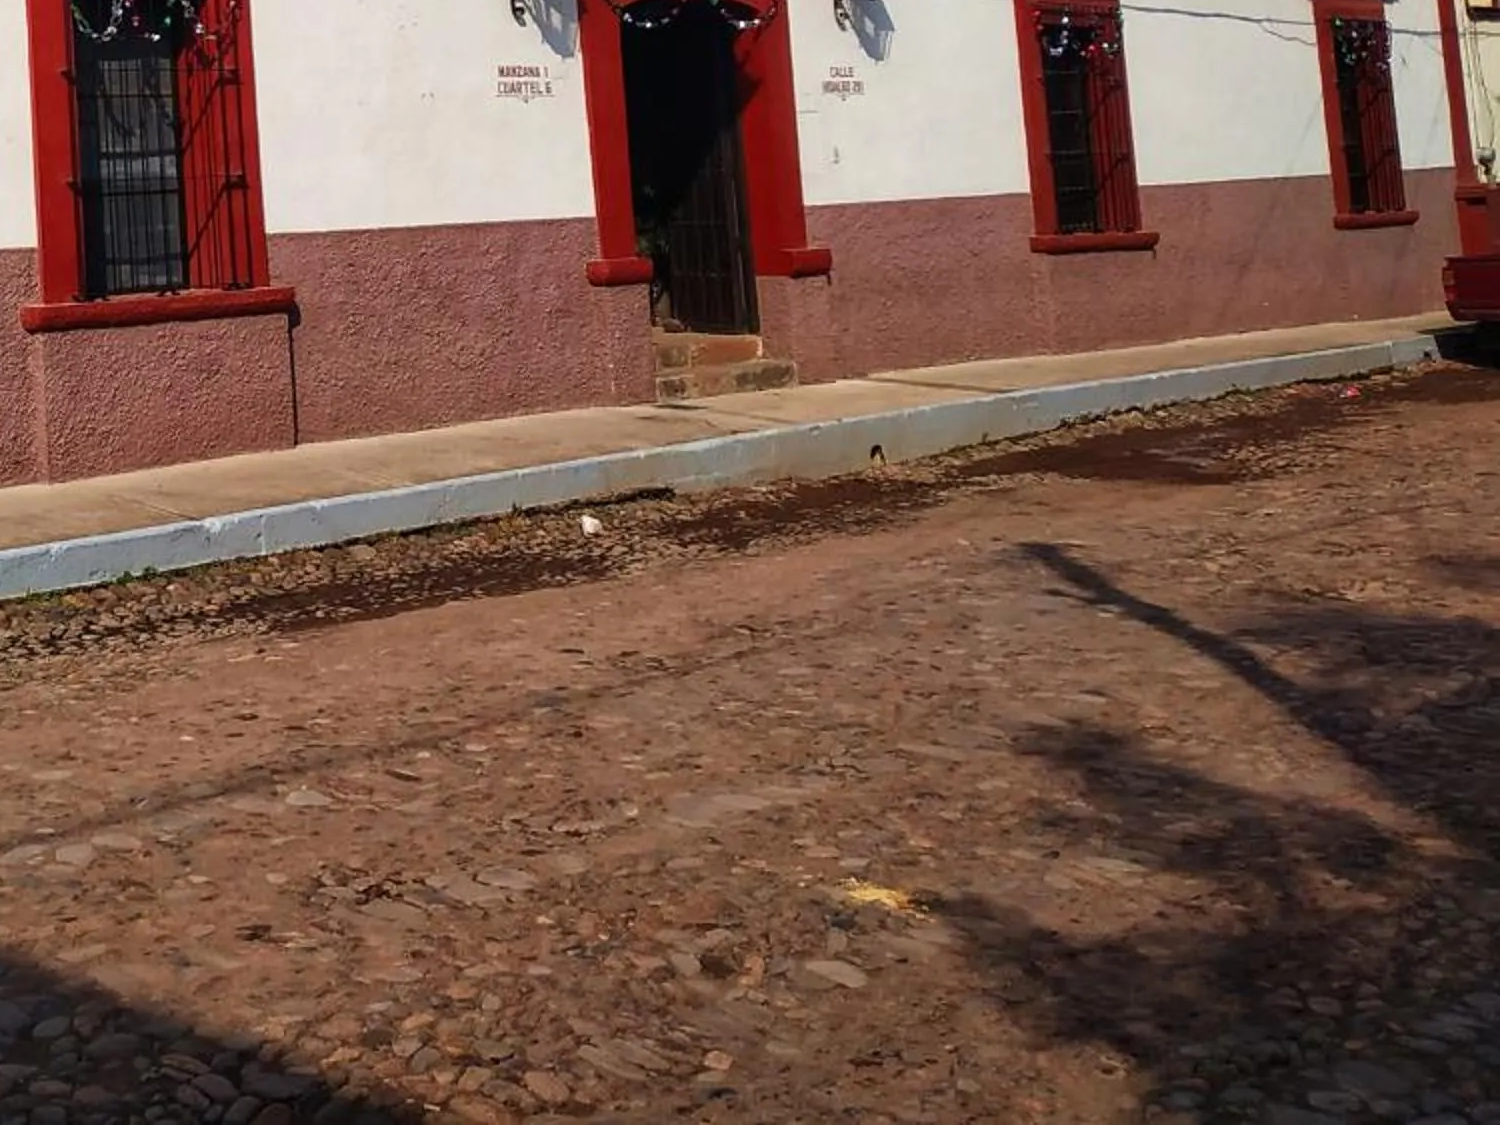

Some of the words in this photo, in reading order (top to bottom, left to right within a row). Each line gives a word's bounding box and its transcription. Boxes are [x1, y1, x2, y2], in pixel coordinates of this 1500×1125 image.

[497, 65, 541, 78] MANZANA
[829, 66, 855, 78] CALLE
[497, 81, 543, 94] CUARTEL
